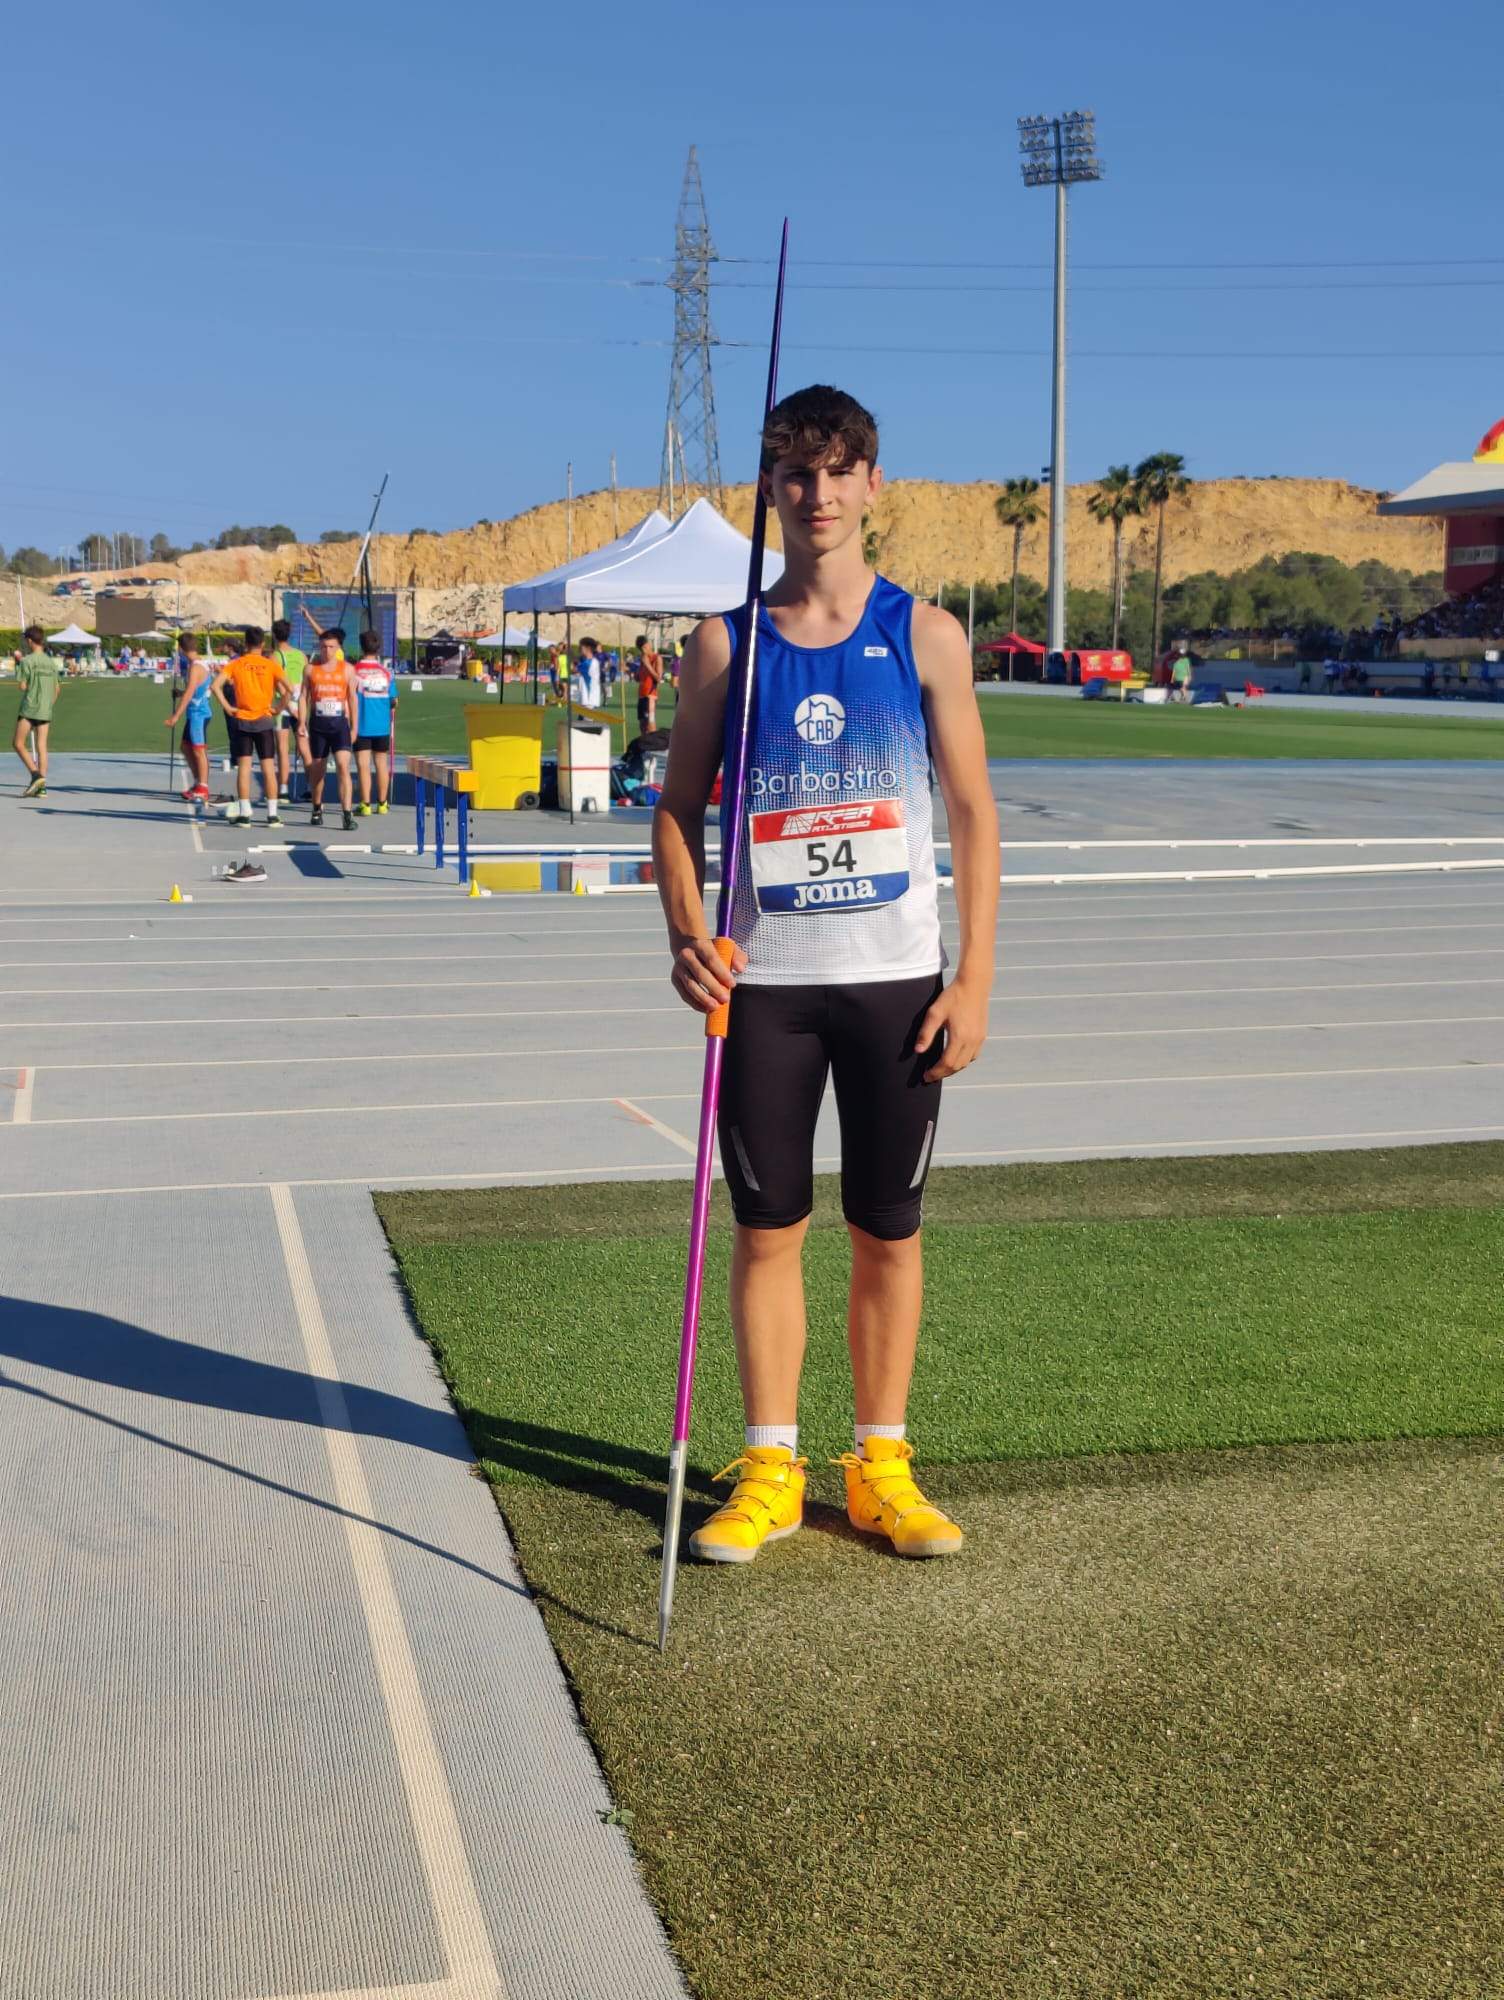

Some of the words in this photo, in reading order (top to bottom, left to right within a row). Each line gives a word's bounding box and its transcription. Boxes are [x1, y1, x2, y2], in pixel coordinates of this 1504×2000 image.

[807, 719, 834, 742] CAB
[751, 761, 896, 795] Barbastro
[815, 806, 874, 824] RFEA
[807, 840, 857, 877] 54
